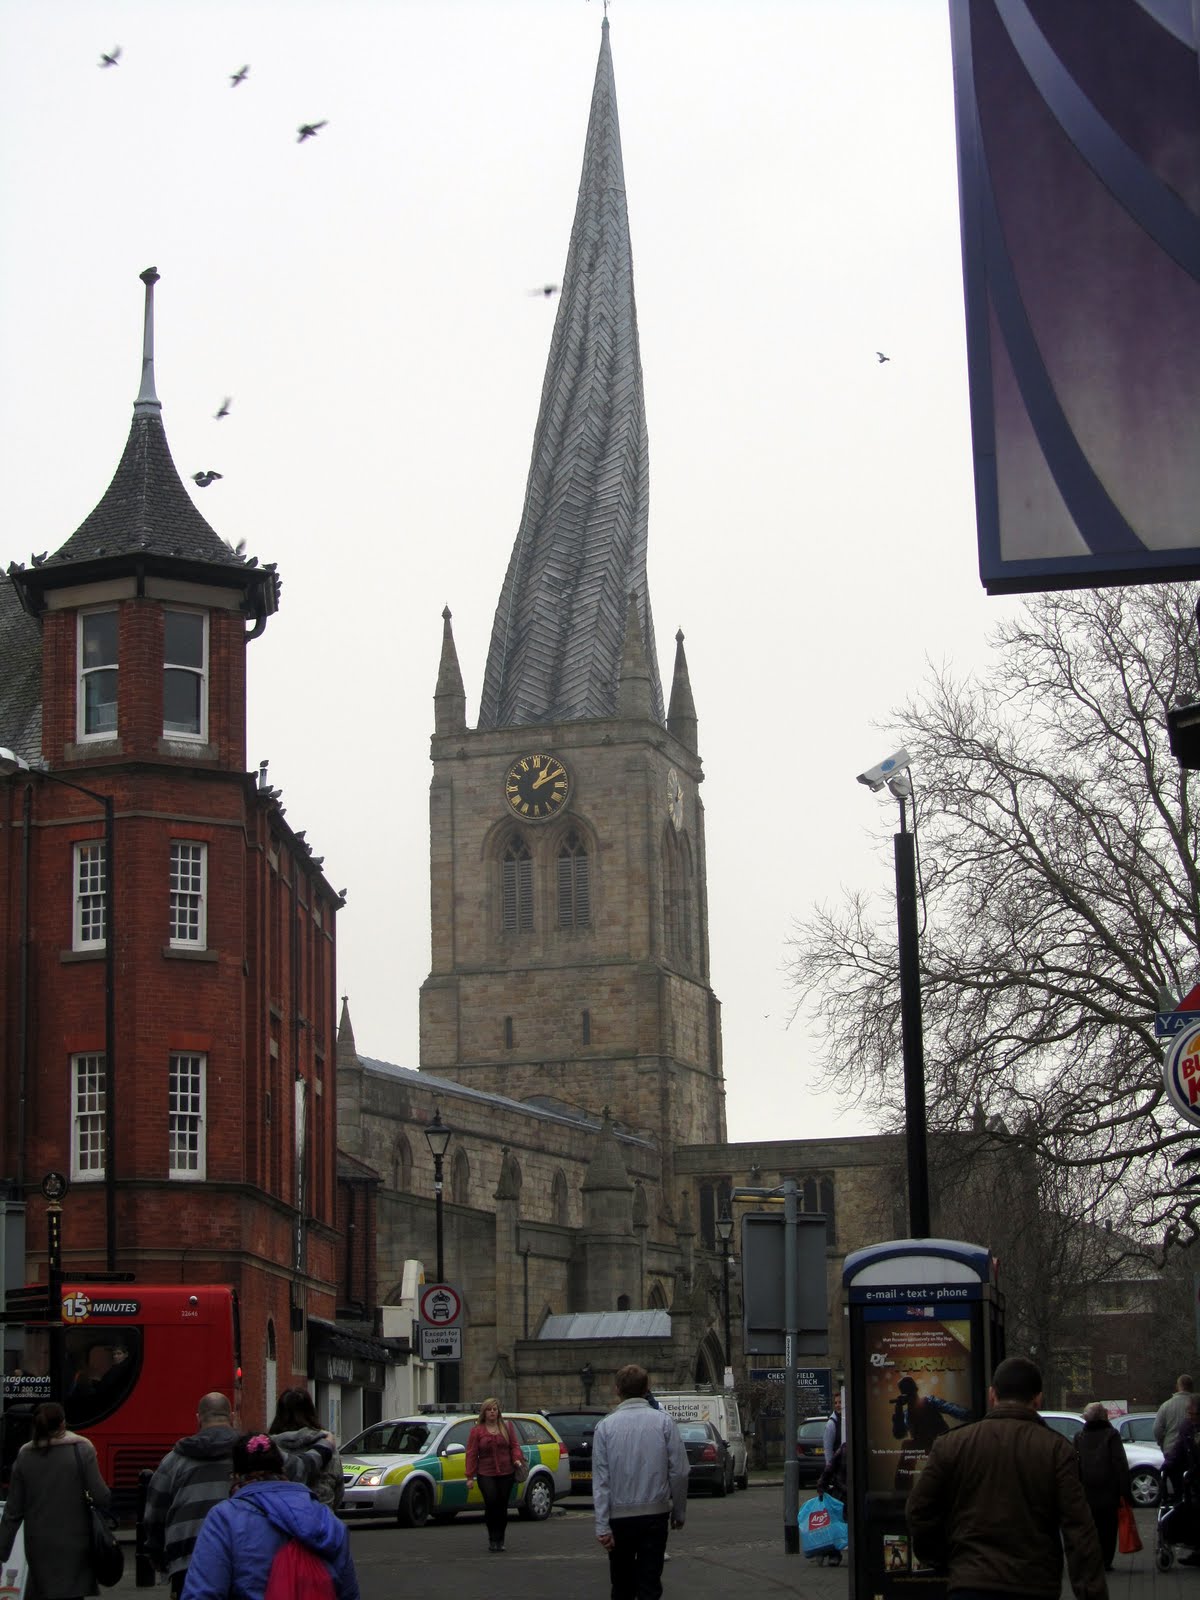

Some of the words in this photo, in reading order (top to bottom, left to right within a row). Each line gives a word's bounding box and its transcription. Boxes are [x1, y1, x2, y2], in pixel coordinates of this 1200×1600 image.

[1159, 1016, 1200, 1029] YA
[866, 1289, 897, 1299] e-mail
[907, 1289, 927, 1298] text
[937, 1287, 968, 1298] phone
[63, 1298, 87, 1317] 15
[93, 1303, 137, 1312] MINUTES
[811, 1512, 828, 1522] Args
